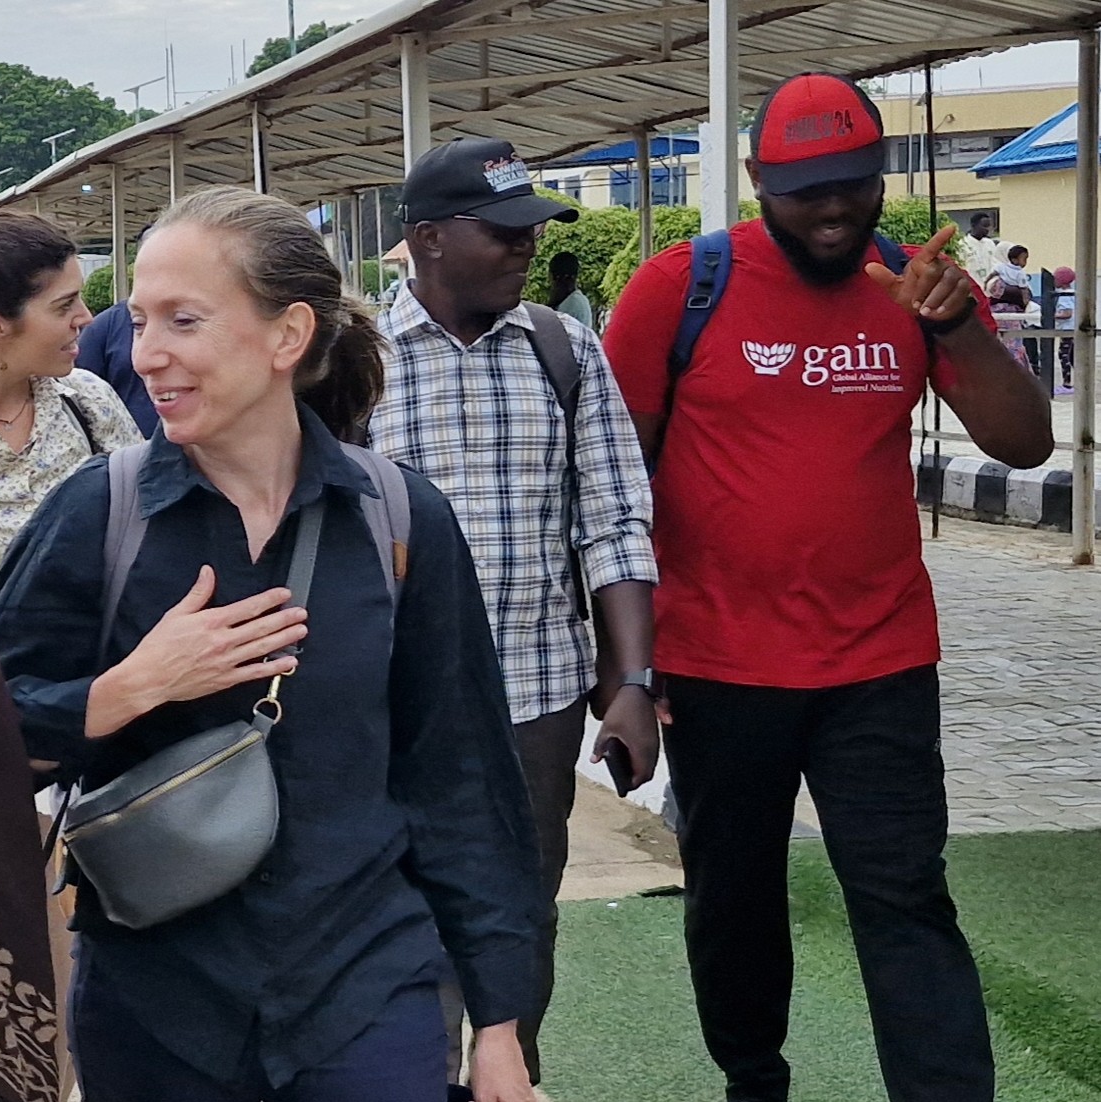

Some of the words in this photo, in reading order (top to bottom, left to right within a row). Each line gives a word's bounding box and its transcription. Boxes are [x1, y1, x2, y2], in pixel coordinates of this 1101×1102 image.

[801, 333, 900, 386] gain
[832, 373, 858, 382] Global
[858, 373, 889, 381] Alliance
[889, 372, 901, 381] for
[831, 384, 868, 394] Improved
[869, 383, 904, 392] Nutrition
